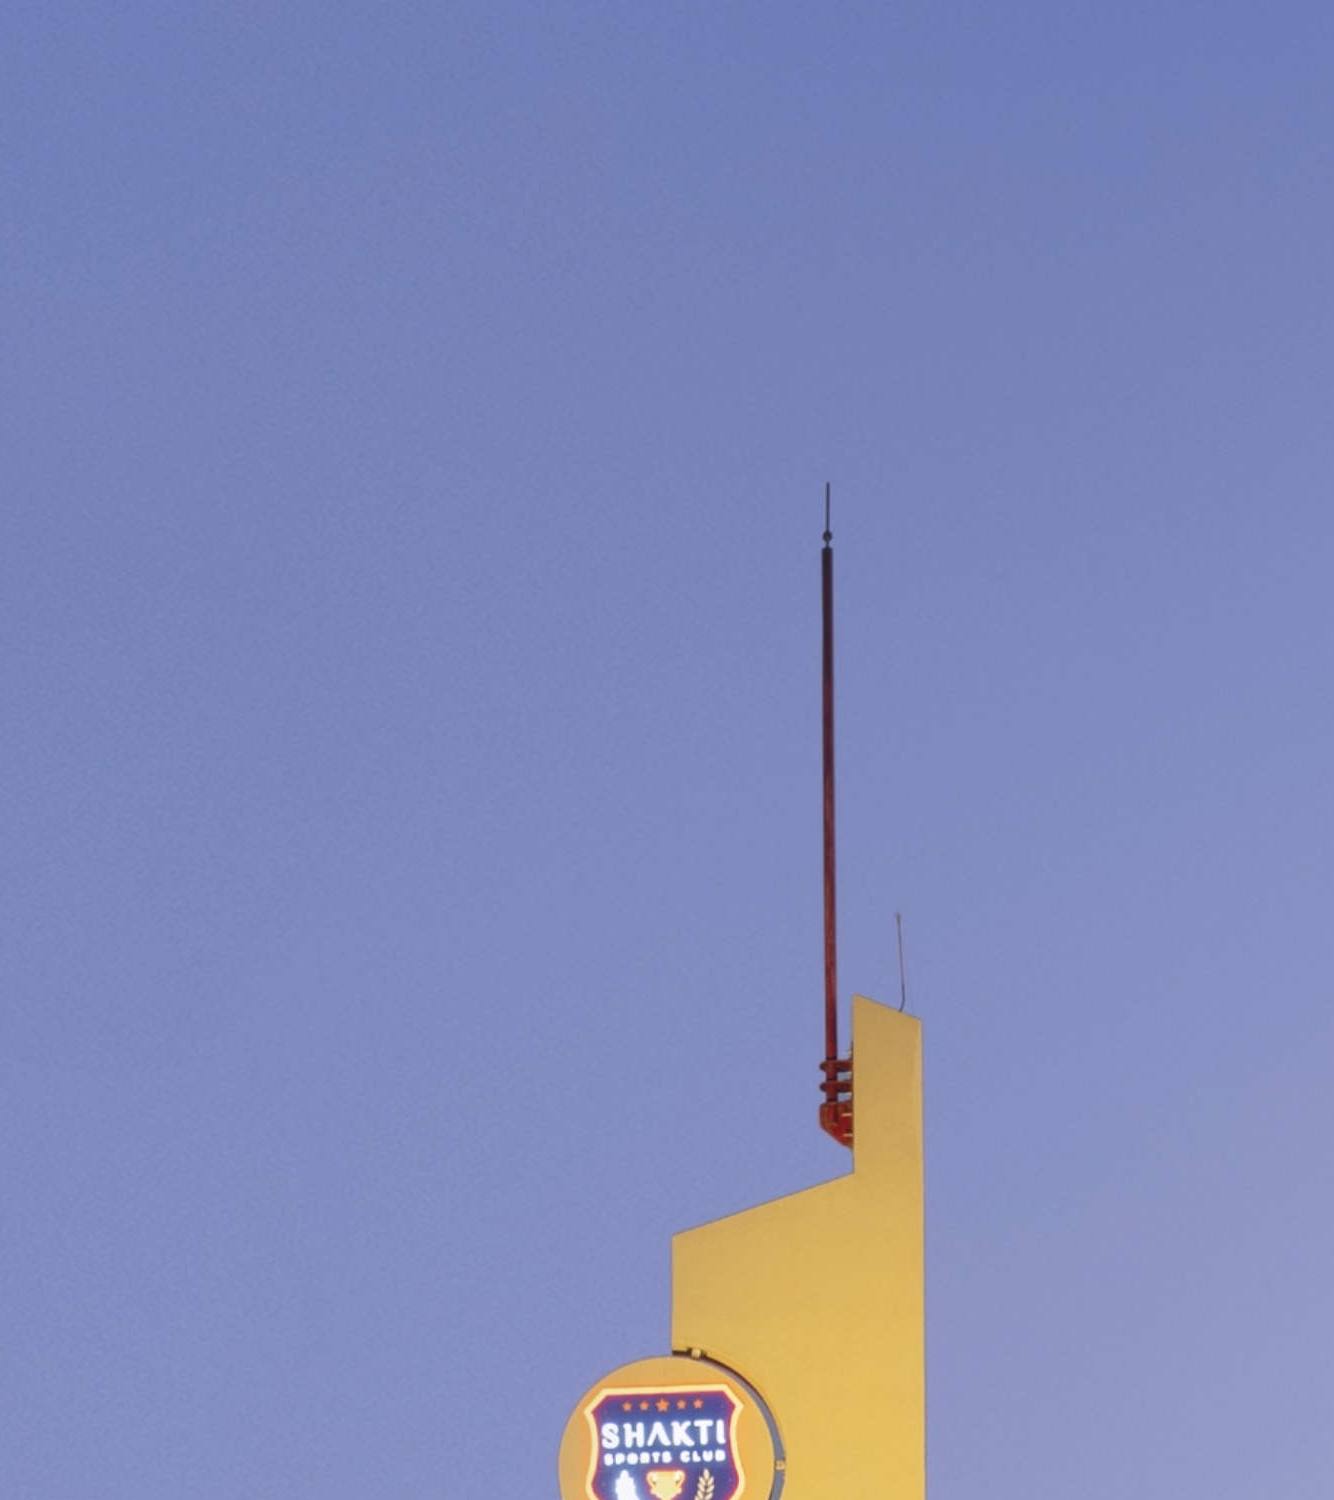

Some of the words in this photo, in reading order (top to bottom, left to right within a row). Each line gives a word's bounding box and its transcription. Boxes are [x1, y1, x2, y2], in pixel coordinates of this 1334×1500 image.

[601, 1419, 726, 1449] SHAKTI
[604, 1451, 672, 1466] SPORTS
[680, 1449, 726, 1463] CLUB
